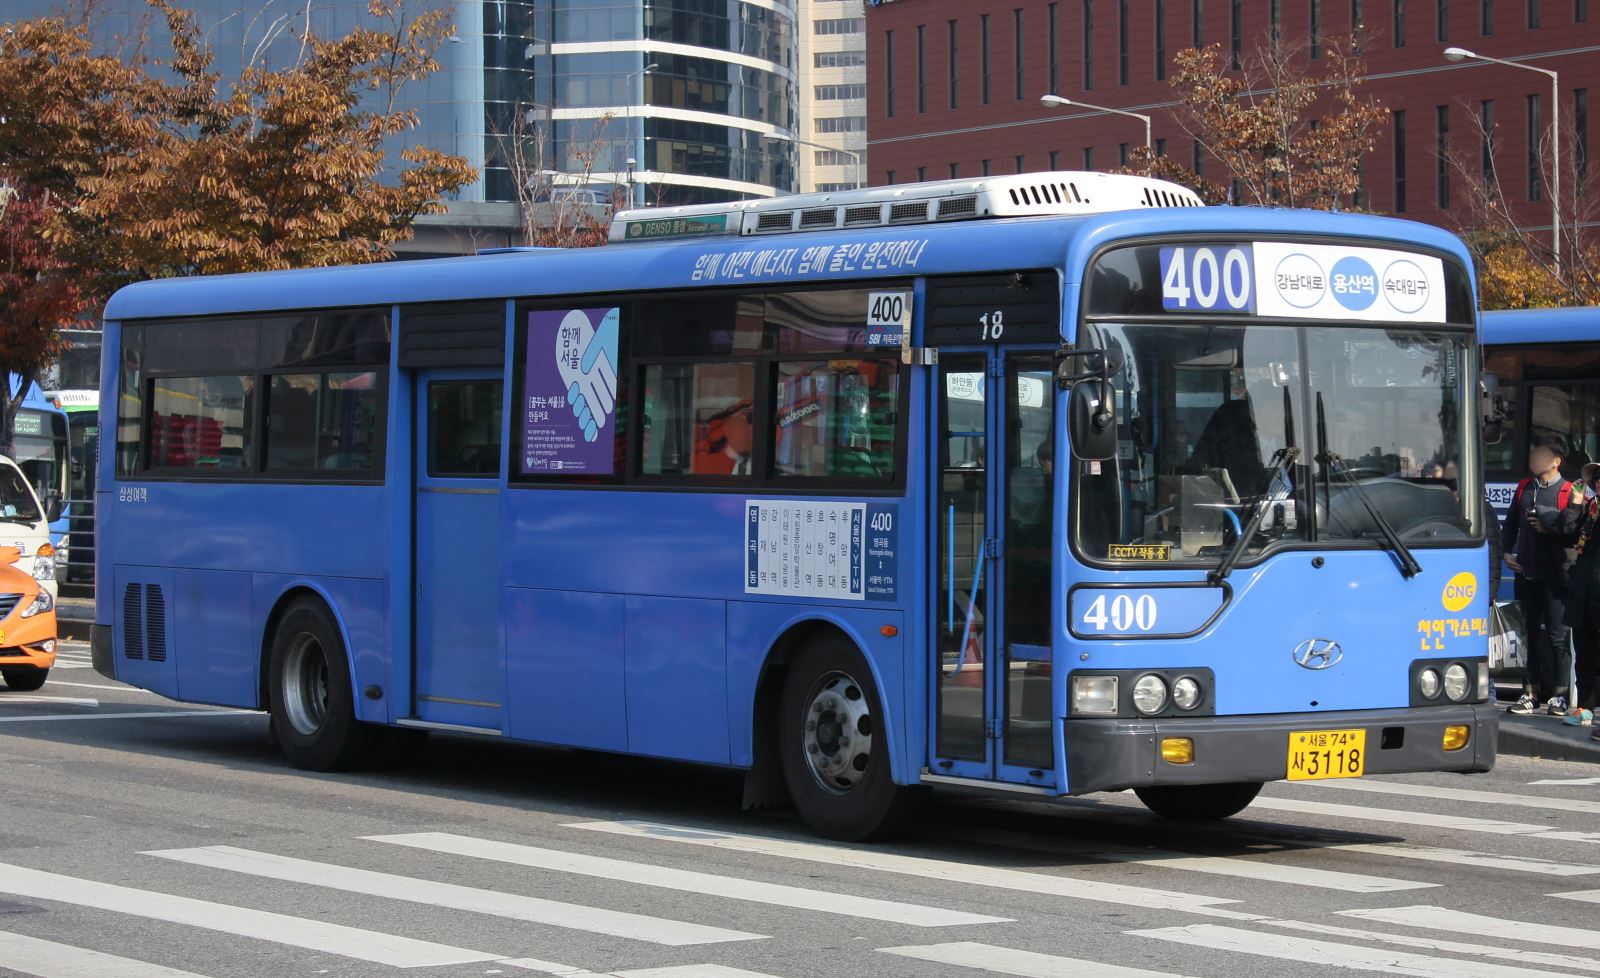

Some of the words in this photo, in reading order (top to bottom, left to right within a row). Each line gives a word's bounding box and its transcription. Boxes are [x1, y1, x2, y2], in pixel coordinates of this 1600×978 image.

[644, 221, 672, 236] DENSO
[691, 254, 725, 281] 함께
[750, 248, 800, 276] 에너지,
[798, 246, 834, 274] 함께
[829, 243, 868, 272] 줄인
[861, 238, 929, 270] 원전하나
[1163, 247, 1250, 308] 400
[1276, 272, 1325, 292] 강남대로
[1333, 273, 1375, 295] 용산역
[1384, 277, 1429, 296] 숙대입구
[871, 296, 902, 323] 400
[979, 310, 1003, 340] 18
[561, 327, 581, 348] 함께
[868, 333, 881, 345] SBI
[560, 348, 580, 370] 서울
[119, 486, 147, 503] 삼성여객
[1485, 487, 1517, 504] 상조업
[870, 512, 893, 532] 400
[1114, 547, 1138, 558] CCTV
[1139, 547, 1154, 560] 작동
[1157, 548, 1165, 560] 중
[1446, 584, 1474, 599] CNG
[1083, 594, 1157, 631] 400
[1308, 734, 1327, 747] 서울
[1332, 734, 1348, 747] 74
